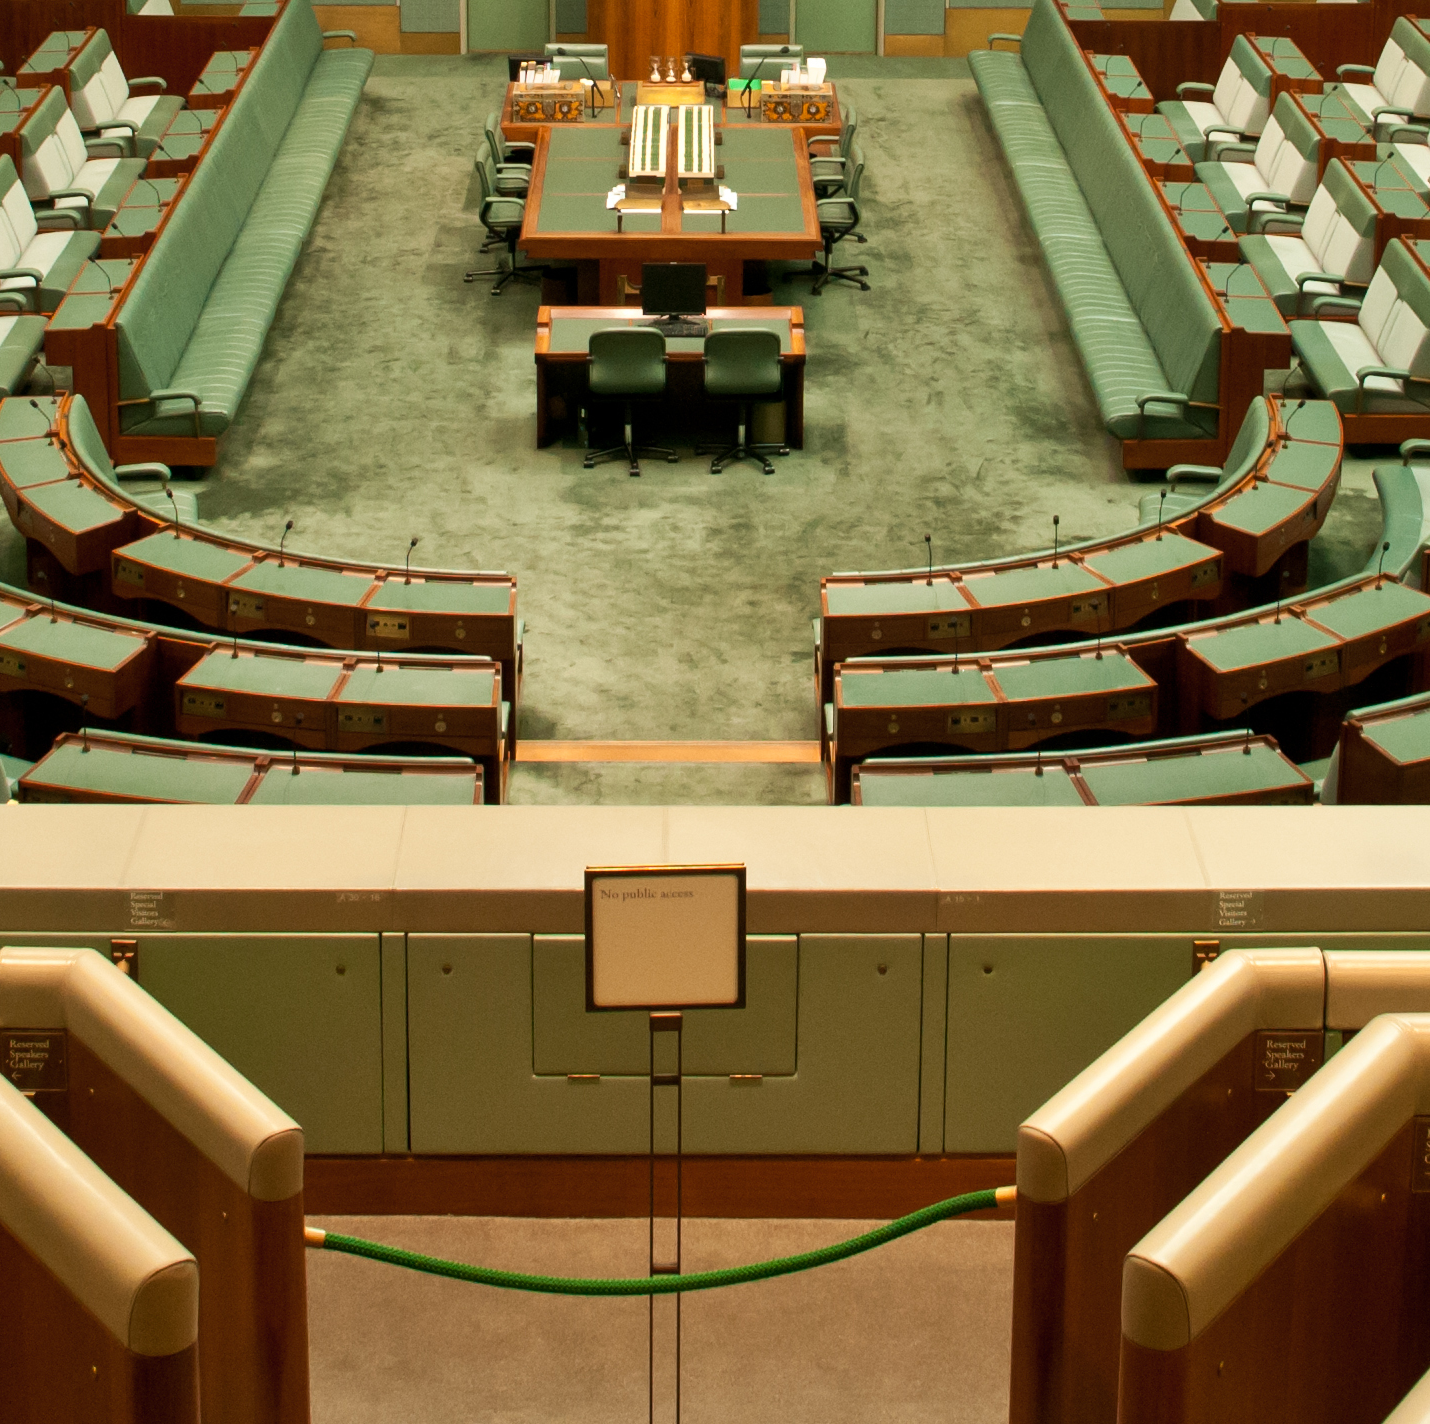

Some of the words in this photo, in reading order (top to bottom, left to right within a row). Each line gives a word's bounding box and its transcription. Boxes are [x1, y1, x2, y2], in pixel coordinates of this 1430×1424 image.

[600, 889, 619, 900] No
[622, 887, 656, 902] public
[660, 890, 694, 899] access
[1219, 891, 1253, 899] Reserved
[1219, 918, 1245, 927] Gallery
[9, 1039, 50, 1048] Reserved
[1266, 1039, 1307, 1049] Reserved
[9, 1050, 49, 1063] Speakers
[1266, 1050, 1305, 1063] Speakers
[9, 1059, 45, 1071] Gallery
[1265, 1059, 1299, 1071] Gallery
